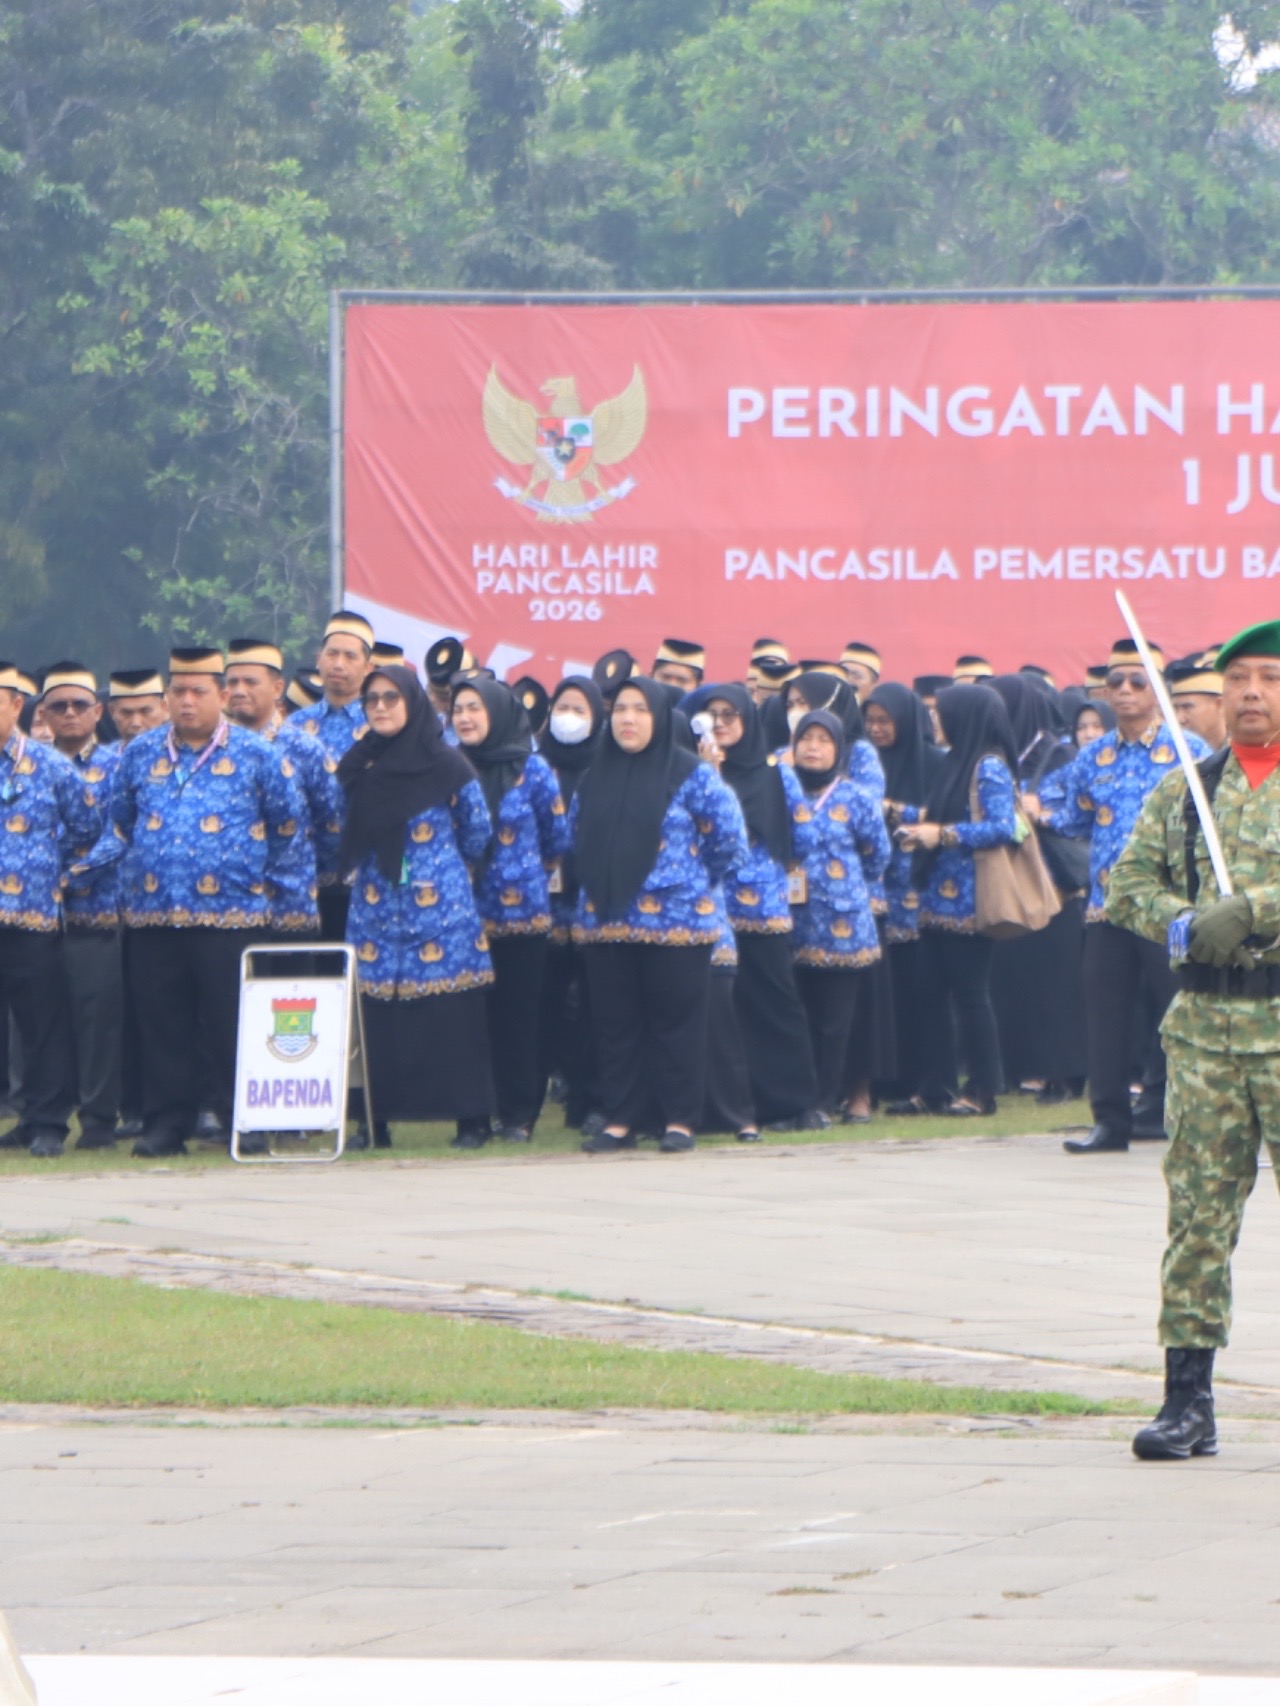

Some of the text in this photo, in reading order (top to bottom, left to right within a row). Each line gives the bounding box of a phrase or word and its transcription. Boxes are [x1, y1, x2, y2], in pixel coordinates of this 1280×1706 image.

[727, 384, 1185, 437] PERINGATAN
[1183, 458, 1200, 505] 1
[472, 544, 658, 569] HARI LAHIR
[725, 548, 959, 580] PANCASILA
[974, 546, 1226, 580] PEMERSATU
[476, 571, 655, 595] PANCASILA
[528, 600, 603, 621] 2026
[247, 1078, 333, 1108] BAPENDA
